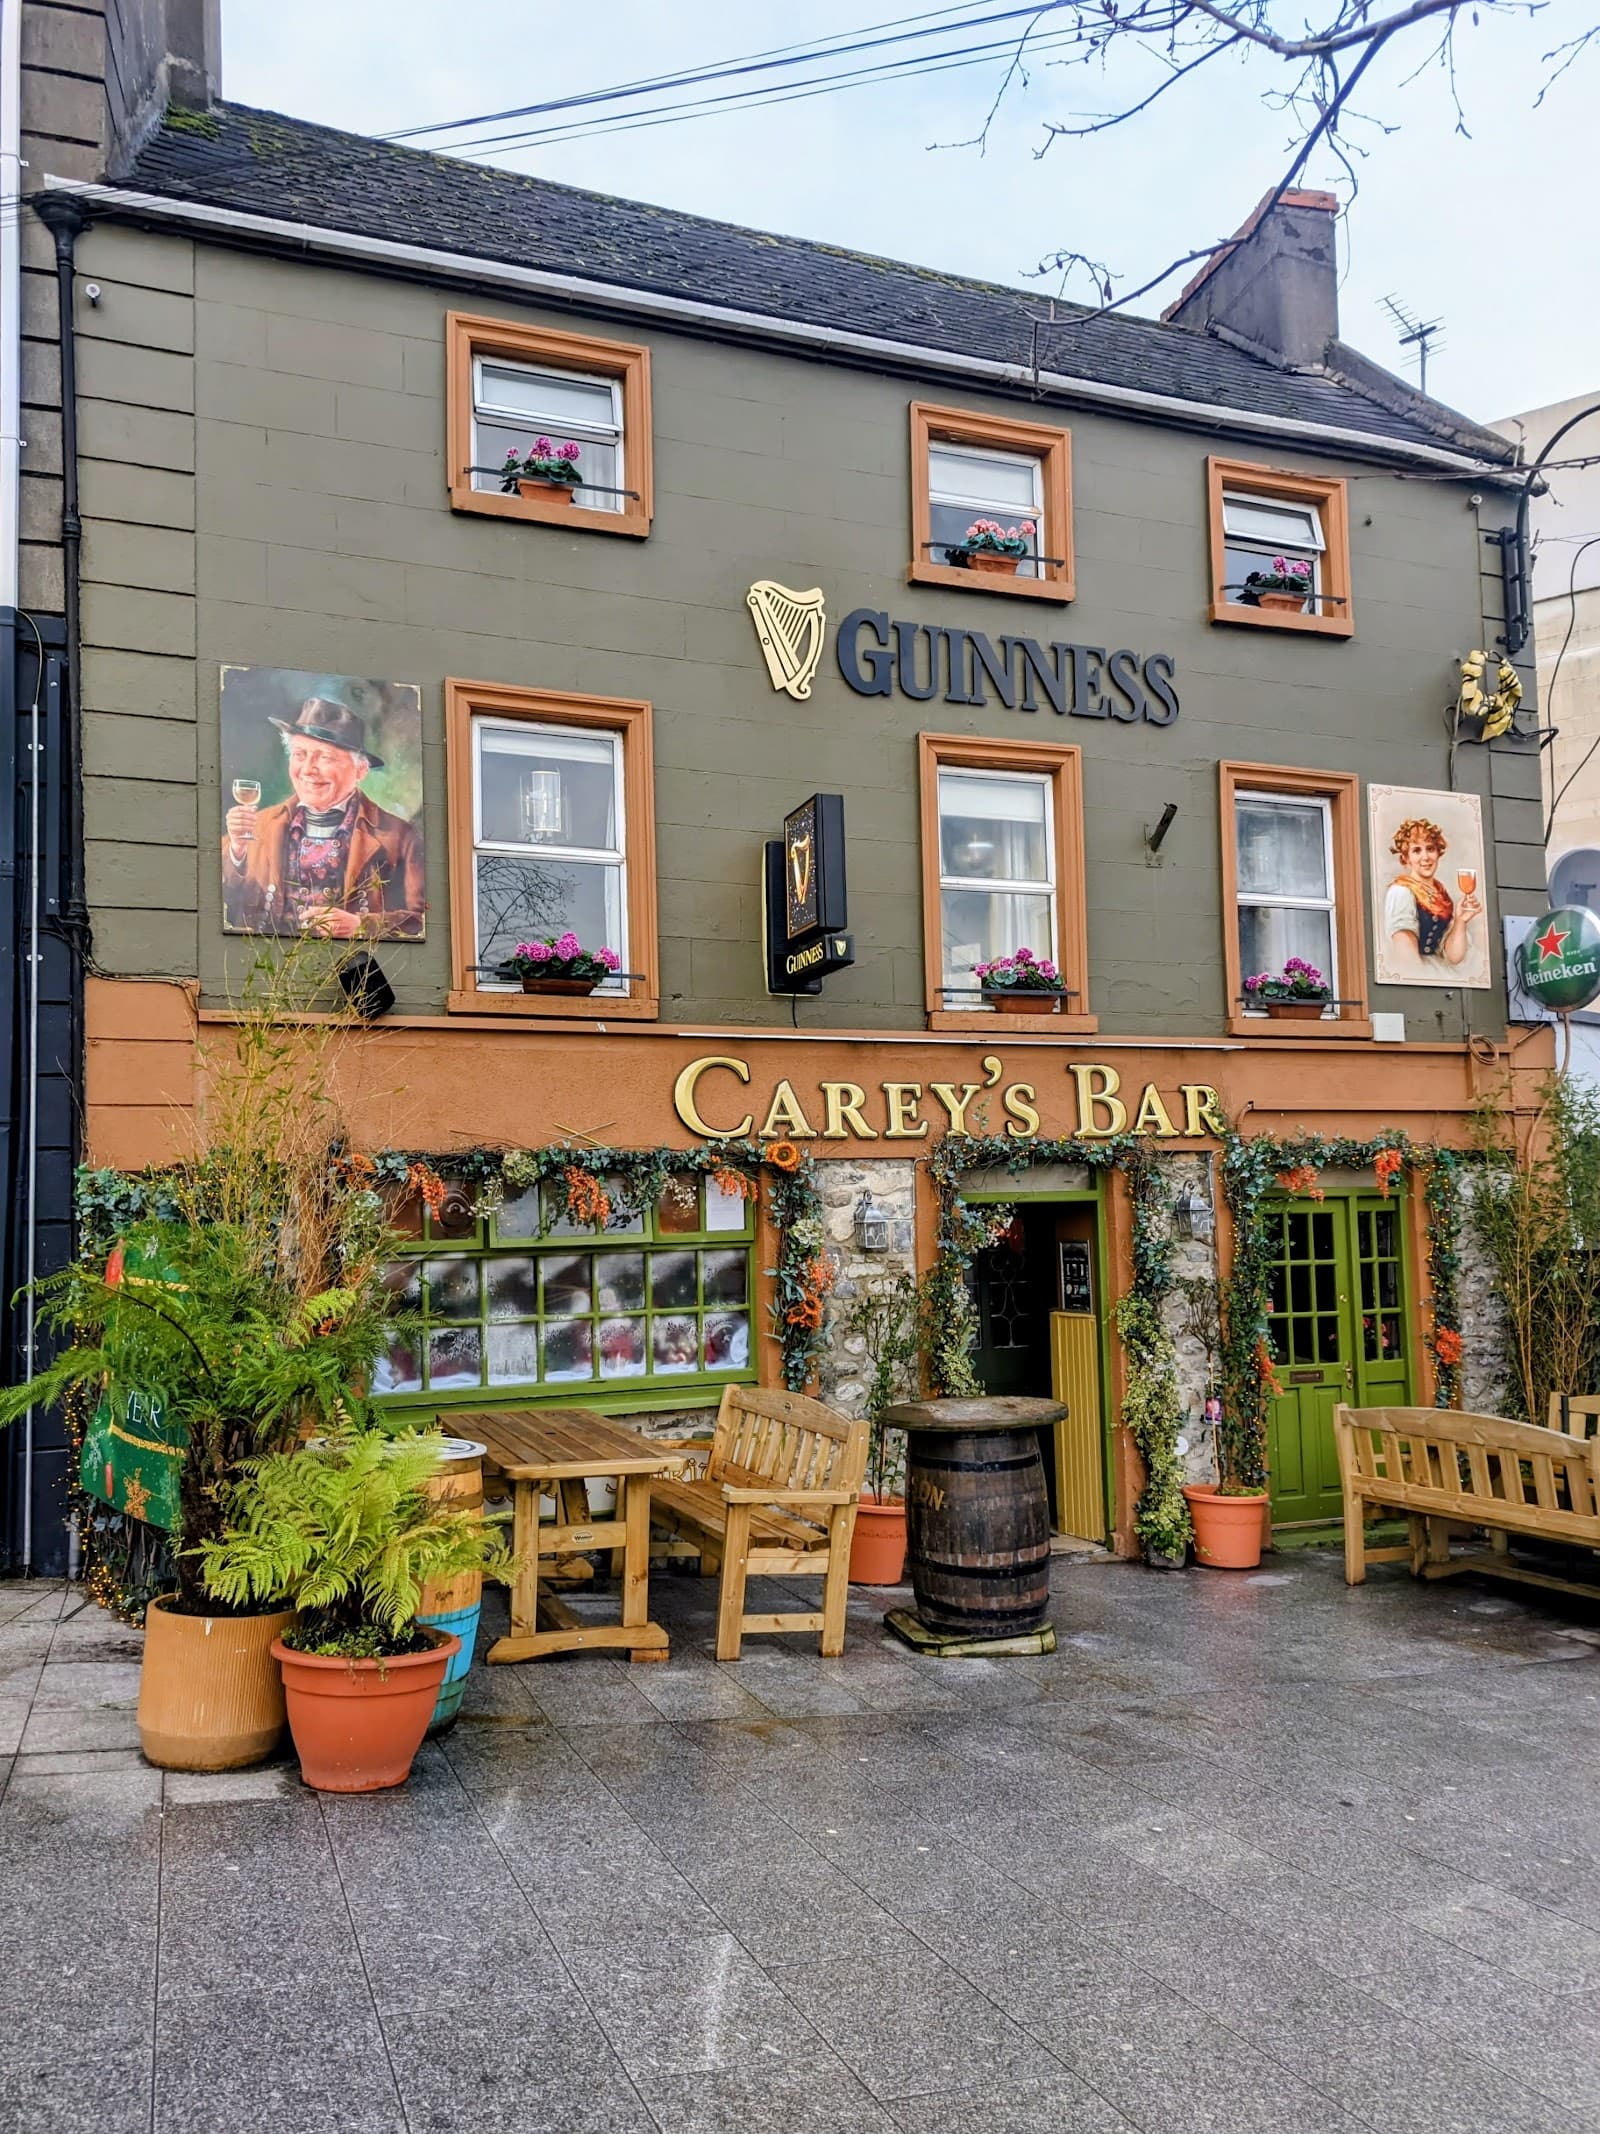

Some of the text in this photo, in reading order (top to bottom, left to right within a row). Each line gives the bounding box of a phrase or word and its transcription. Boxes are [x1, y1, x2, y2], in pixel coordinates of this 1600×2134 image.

[837, 608, 1179, 727] GUINNESS
[786, 943, 823, 975] GUINNESS
[1525, 962, 1597, 987] Heineken
[673, 1055, 1226, 1139] CAREY'S BAR
